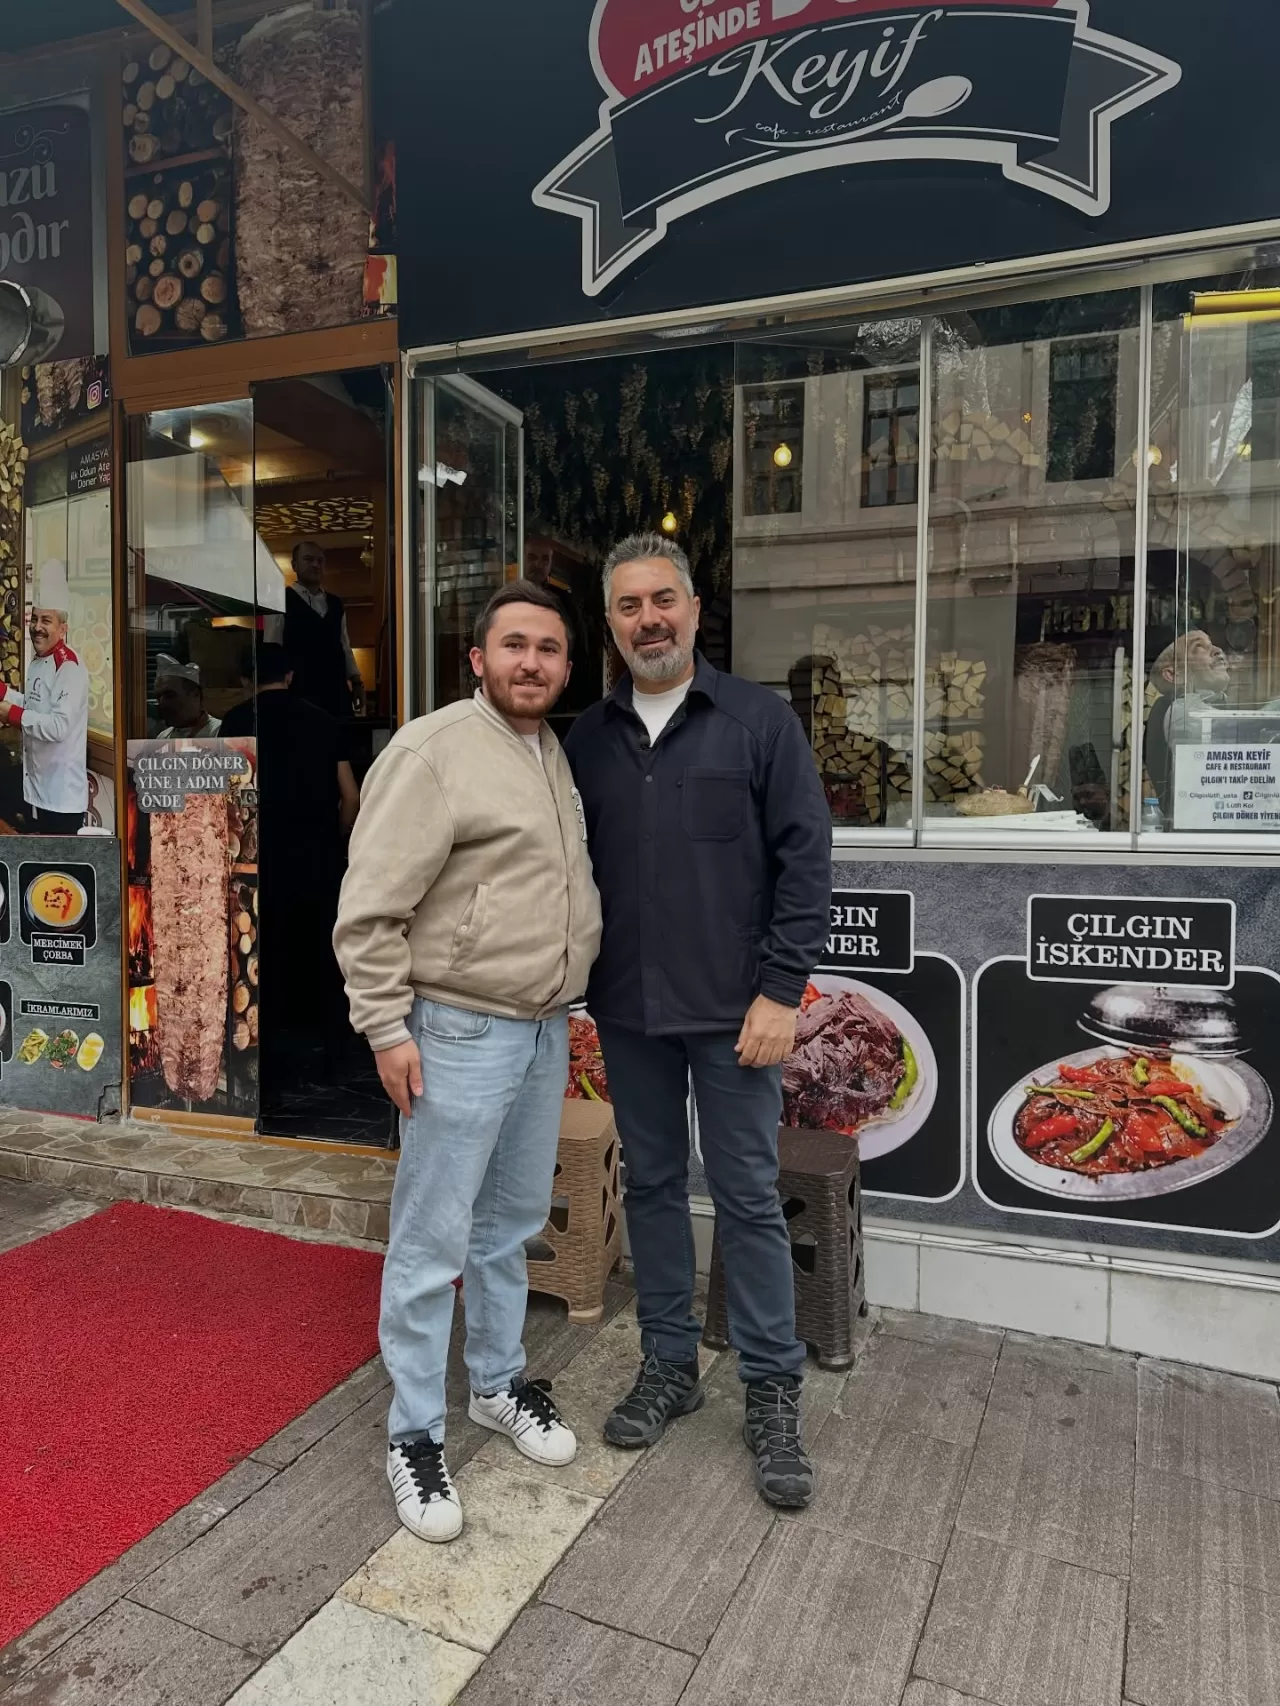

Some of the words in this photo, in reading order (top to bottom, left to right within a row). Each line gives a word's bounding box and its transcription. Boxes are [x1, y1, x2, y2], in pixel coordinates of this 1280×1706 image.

[634, 0, 761, 82] ATEŞİNDE
[694, 9, 944, 124] Keyif
[755, 122, 788, 140] cafe
[1206, 751, 1244, 761] AMASYA
[1246, 748, 1271, 761] KEYİF
[138, 757, 188, 774] ÇILGIN
[192, 754, 244, 770] DÖNER
[1205, 763, 1222, 771] CAFE
[1230, 763, 1271, 771] RESTAURANT
[138, 773, 172, 789] YİNE
[176, 776, 182, 789] 1
[185, 776, 225, 789] ADIM
[1229, 775, 1249, 784] TAKİP
[1250, 775, 1276, 784] EDELİM
[142, 792, 181, 808] ÖNDE
[1212, 811, 1235, 821] ÇILGIN
[1236, 809, 1259, 820] DÖNER
[829, 905, 879, 928] GIN
[1066, 913, 1194, 942] ÇILGIN
[33, 937, 83, 950] MERCİMEK
[822, 934, 880, 957] NER
[43, 950, 74, 961] ÇORBA
[1035, 935, 1225, 973] İSKENDER
[26, 1002, 94, 1018] İKRAMLARIMIZ
